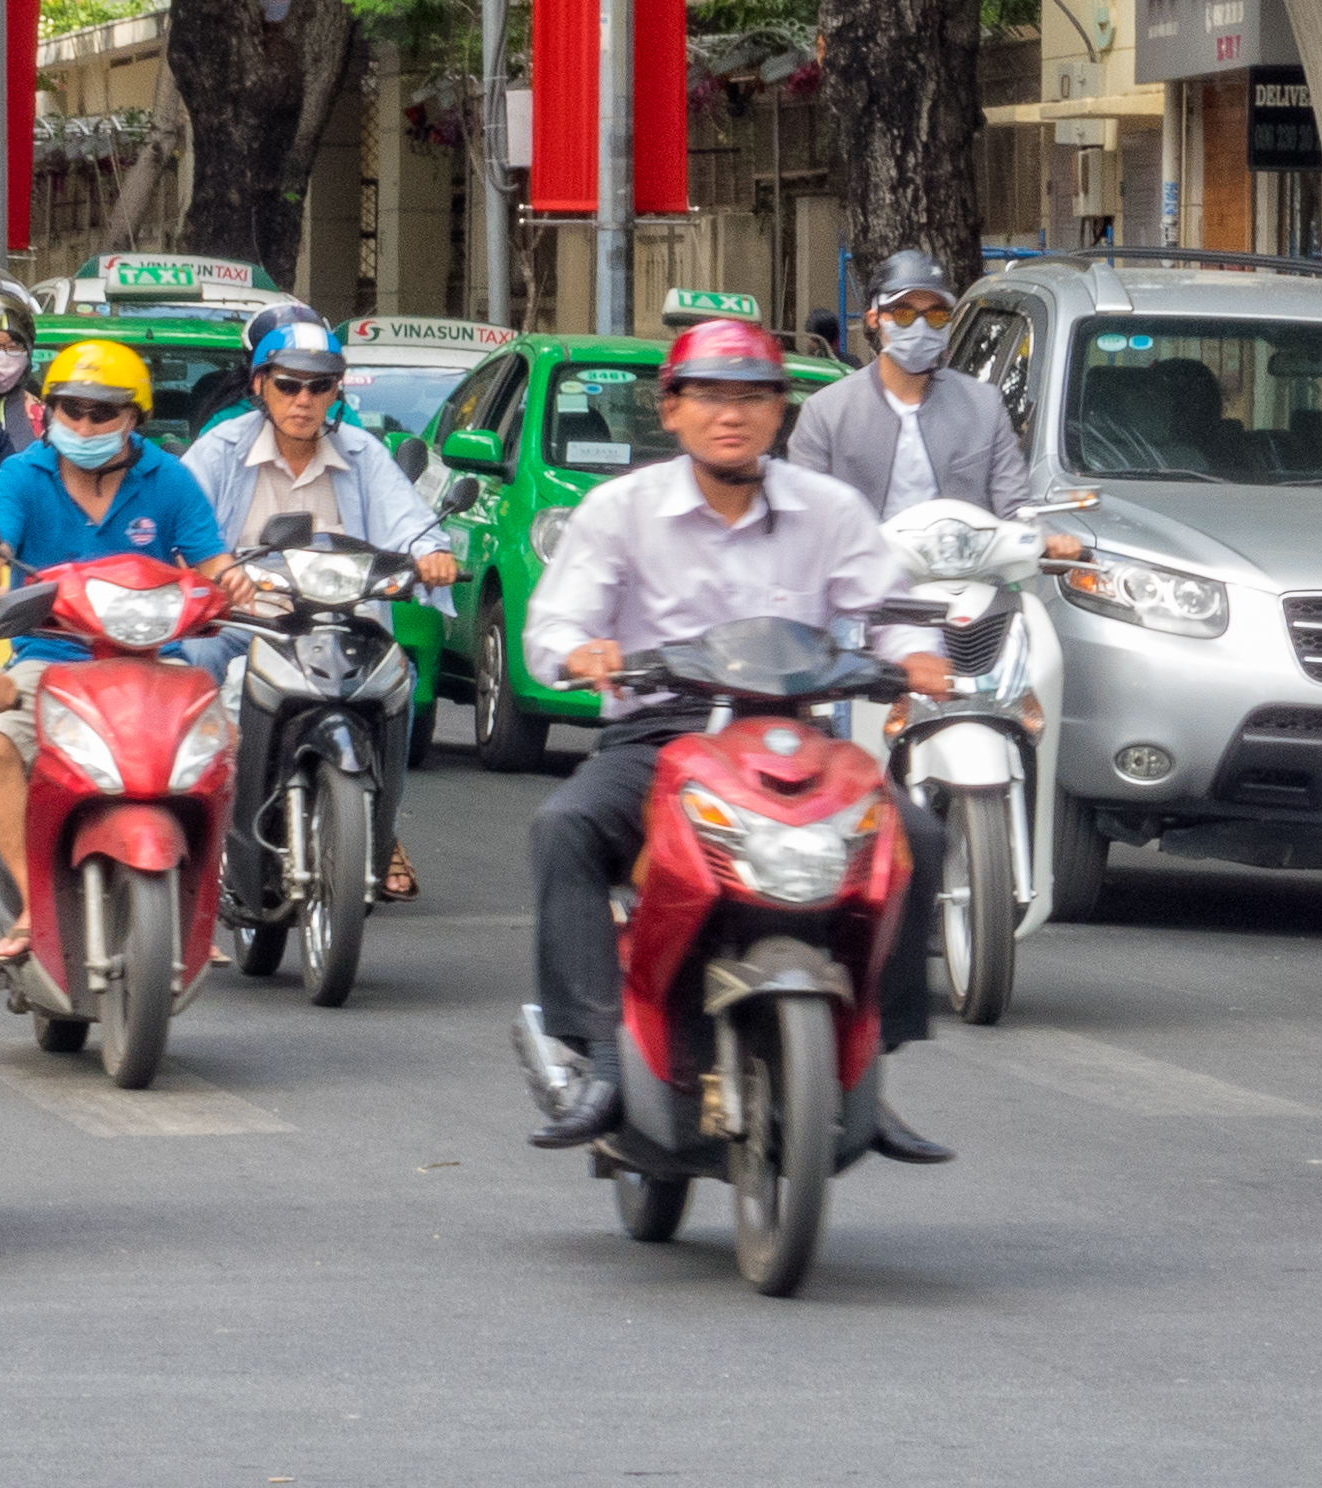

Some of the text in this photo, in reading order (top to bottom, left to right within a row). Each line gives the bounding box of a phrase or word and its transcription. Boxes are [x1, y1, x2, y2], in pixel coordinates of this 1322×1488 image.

[1256, 84, 1312, 107] DELIVE
[215, 265, 248, 282] TAXI
[390, 323, 515, 344] VINASUN TAXI
